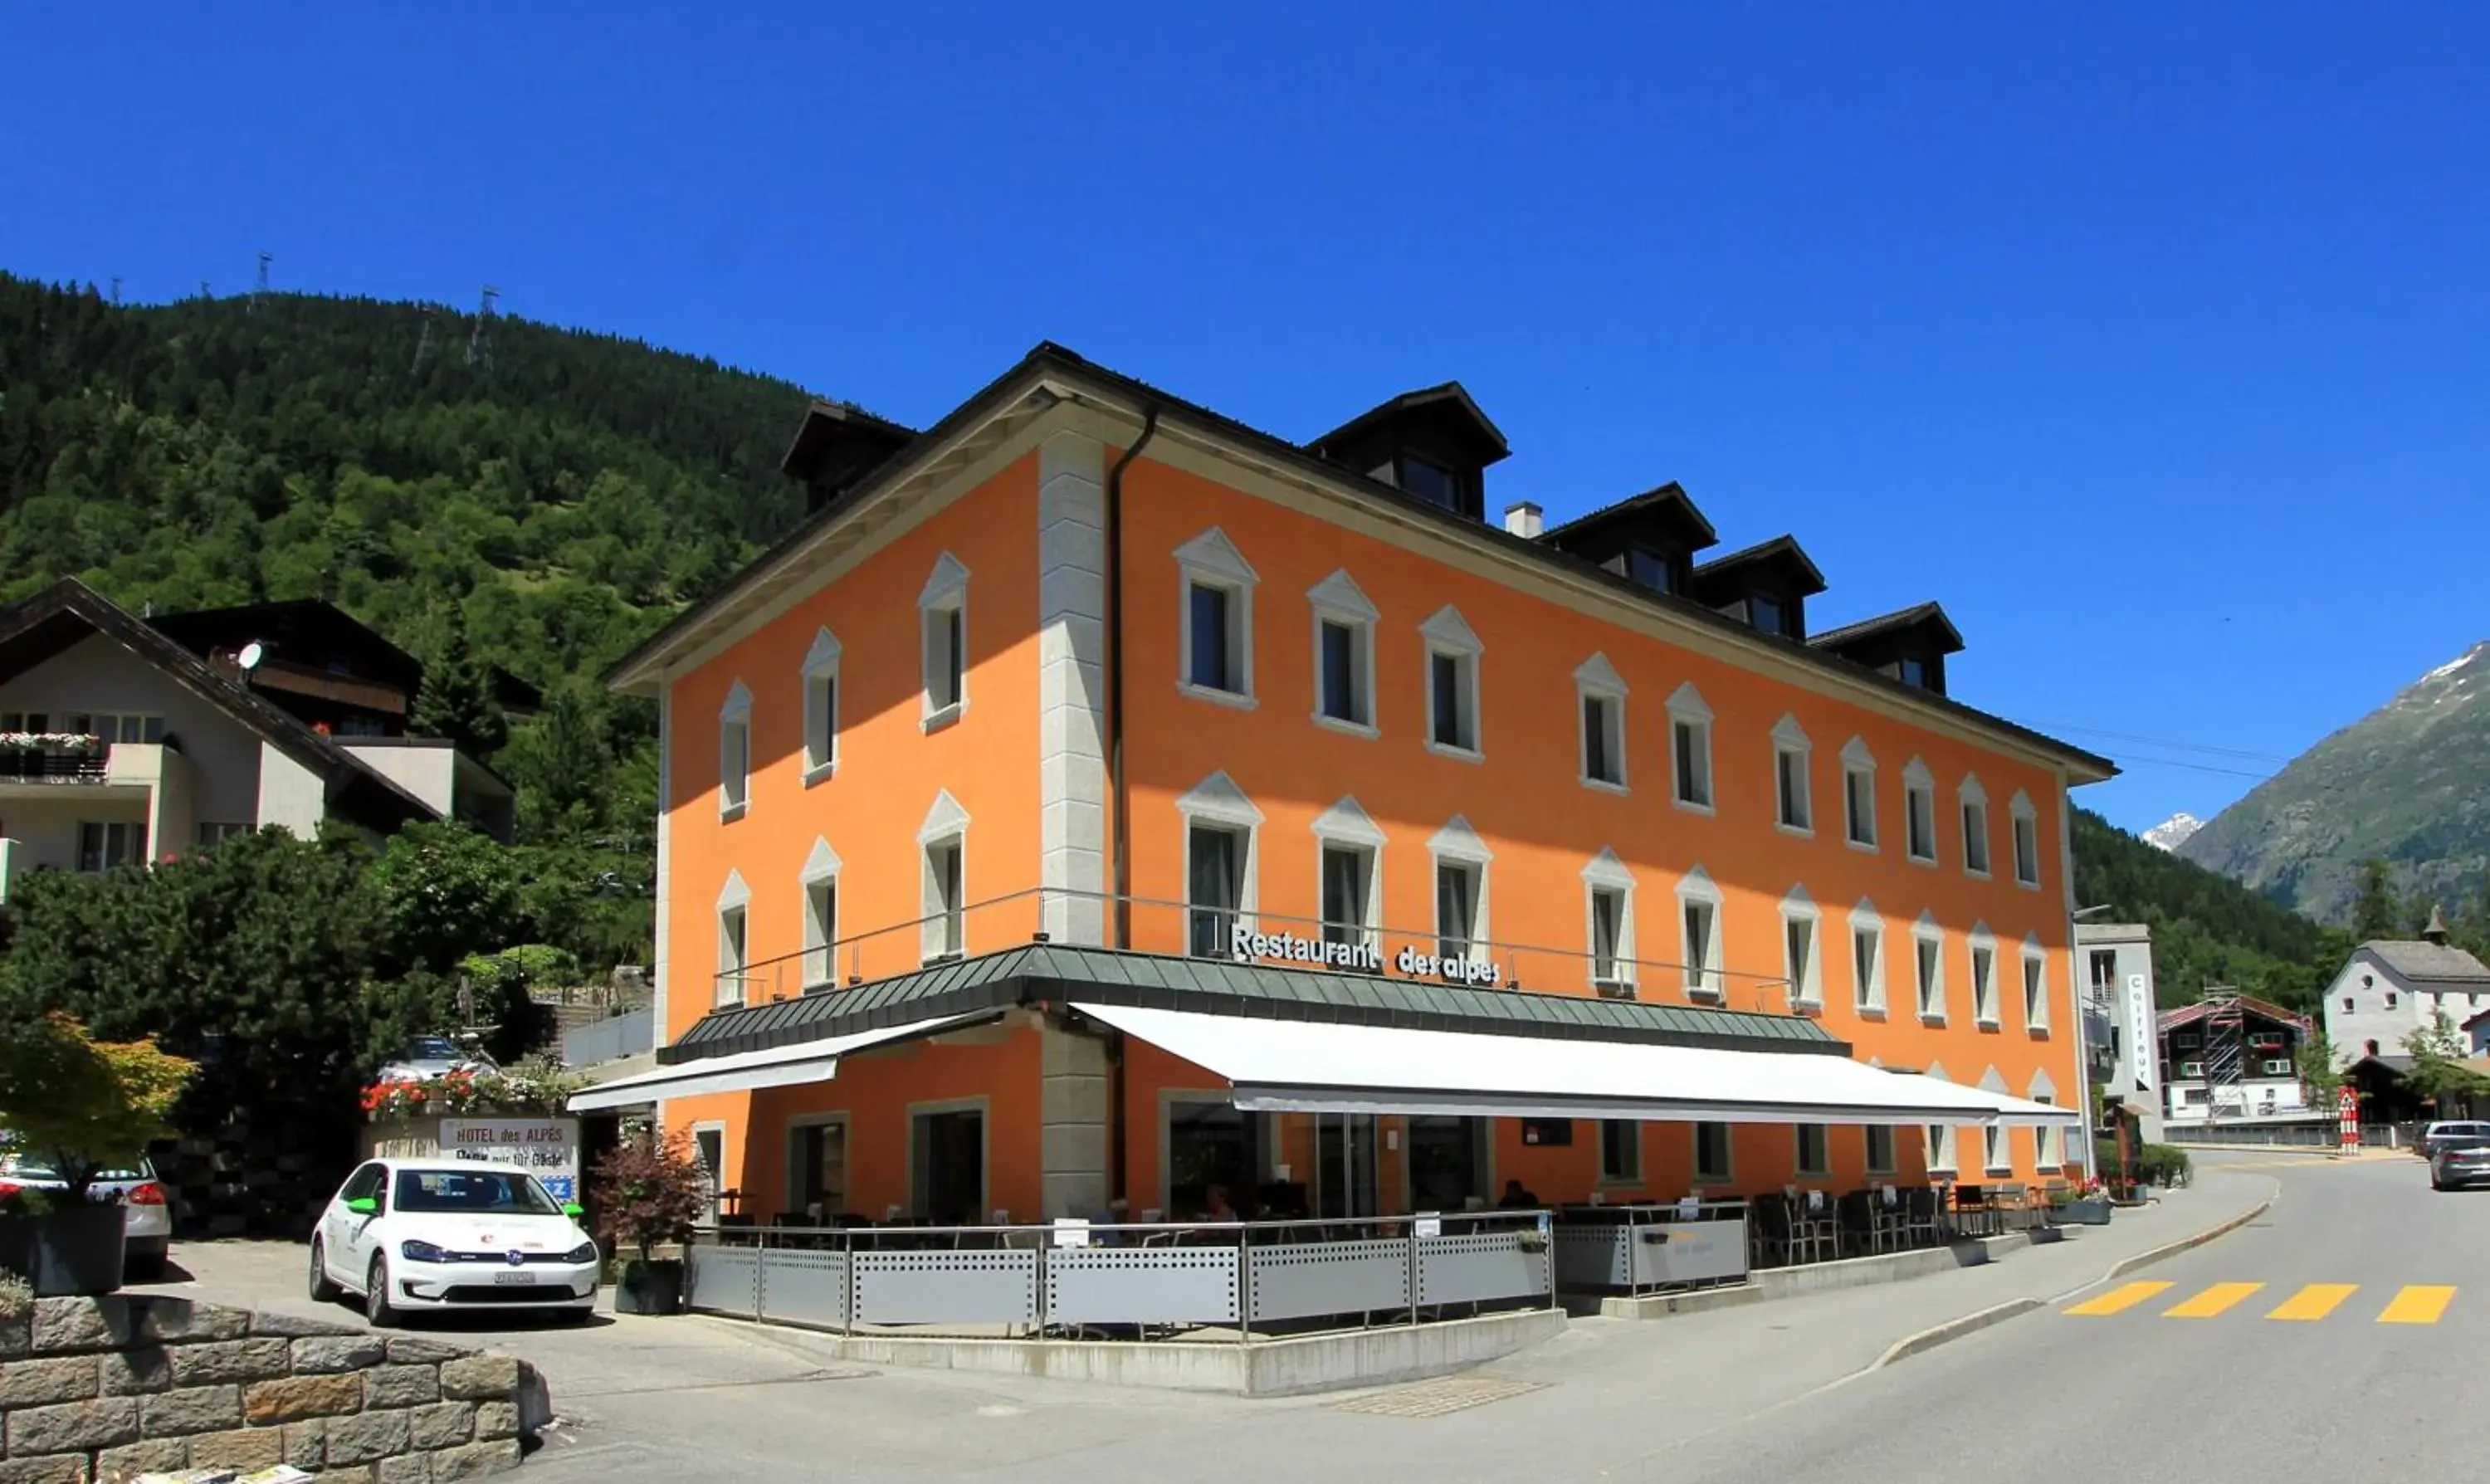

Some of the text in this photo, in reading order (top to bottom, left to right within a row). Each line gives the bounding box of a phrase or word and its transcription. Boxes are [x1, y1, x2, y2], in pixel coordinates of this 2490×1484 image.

[1232, 923, 1500, 985] Restaurant des alpes
[2131, 976, 2146, 1079] Coiffeur
[457, 1128, 496, 1143] HOTEL
[500, 1128, 520, 1143] des
